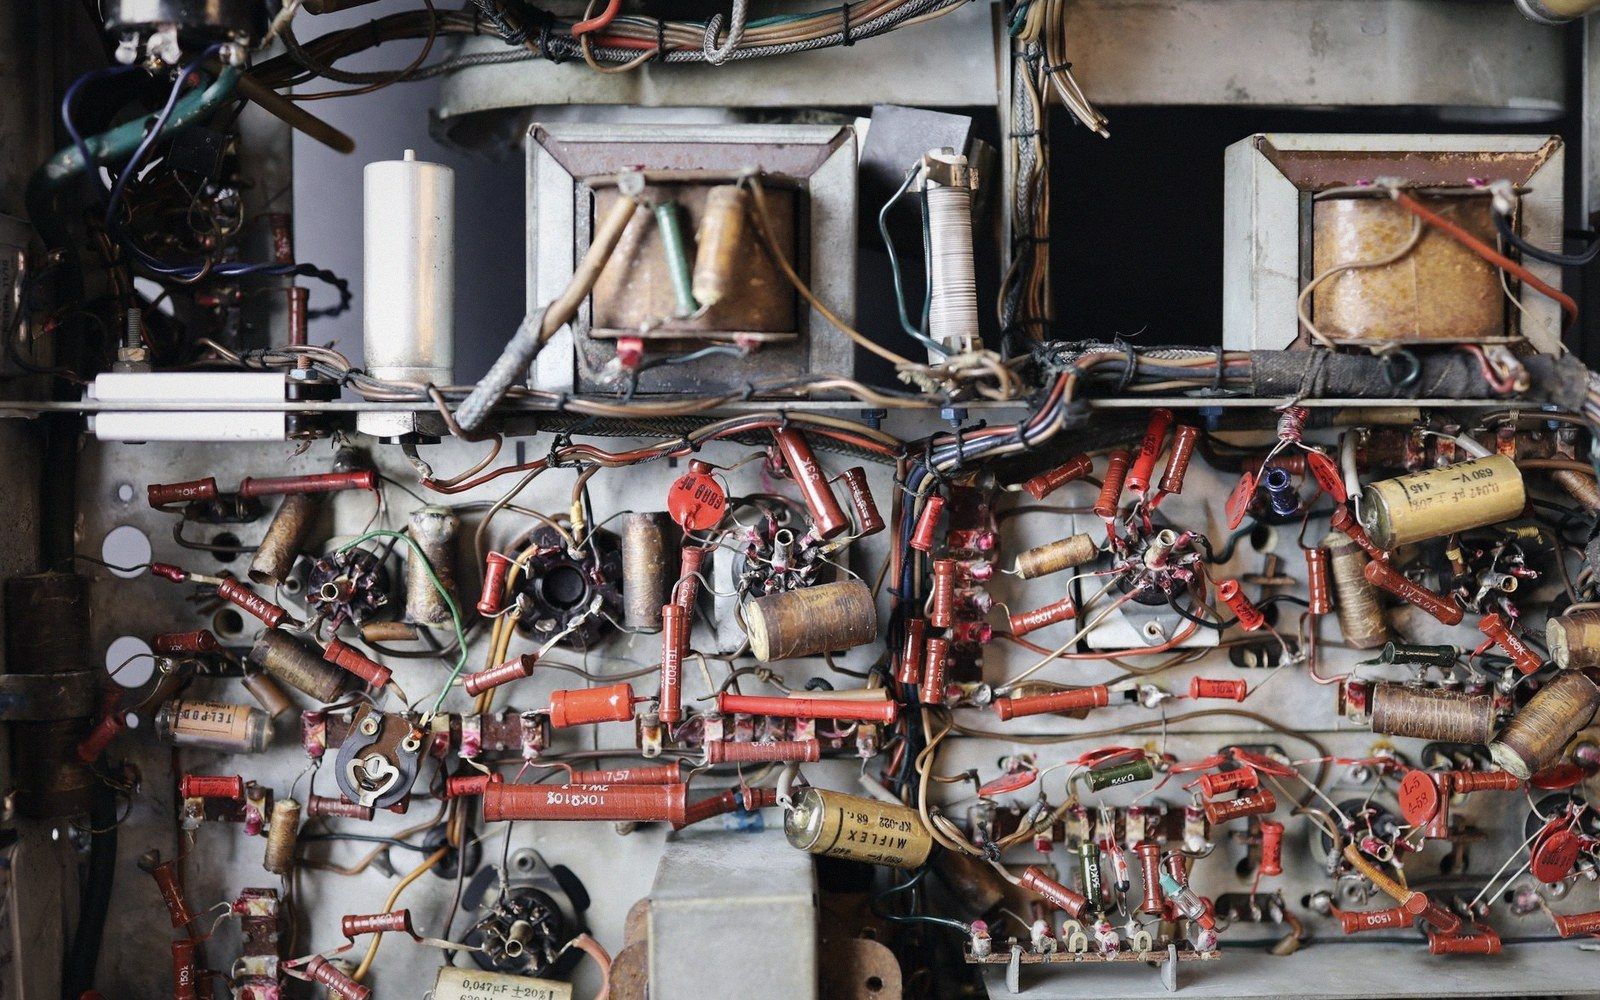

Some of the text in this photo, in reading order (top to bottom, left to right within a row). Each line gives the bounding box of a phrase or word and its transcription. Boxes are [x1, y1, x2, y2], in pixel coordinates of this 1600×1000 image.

[804, 456, 820, 483] 33K
[1471, 467, 1494, 480] 630
[1410, 481, 1431, 494] 445
[1507, 633, 1526, 656] 100K
[668, 648, 678, 686] TELPOD
[182, 709, 232, 724] TELPOD
[857, 813, 868, 825] 68
[848, 830, 907, 849] MIFLEX
[1366, 914, 1392, 925] 150Ω
